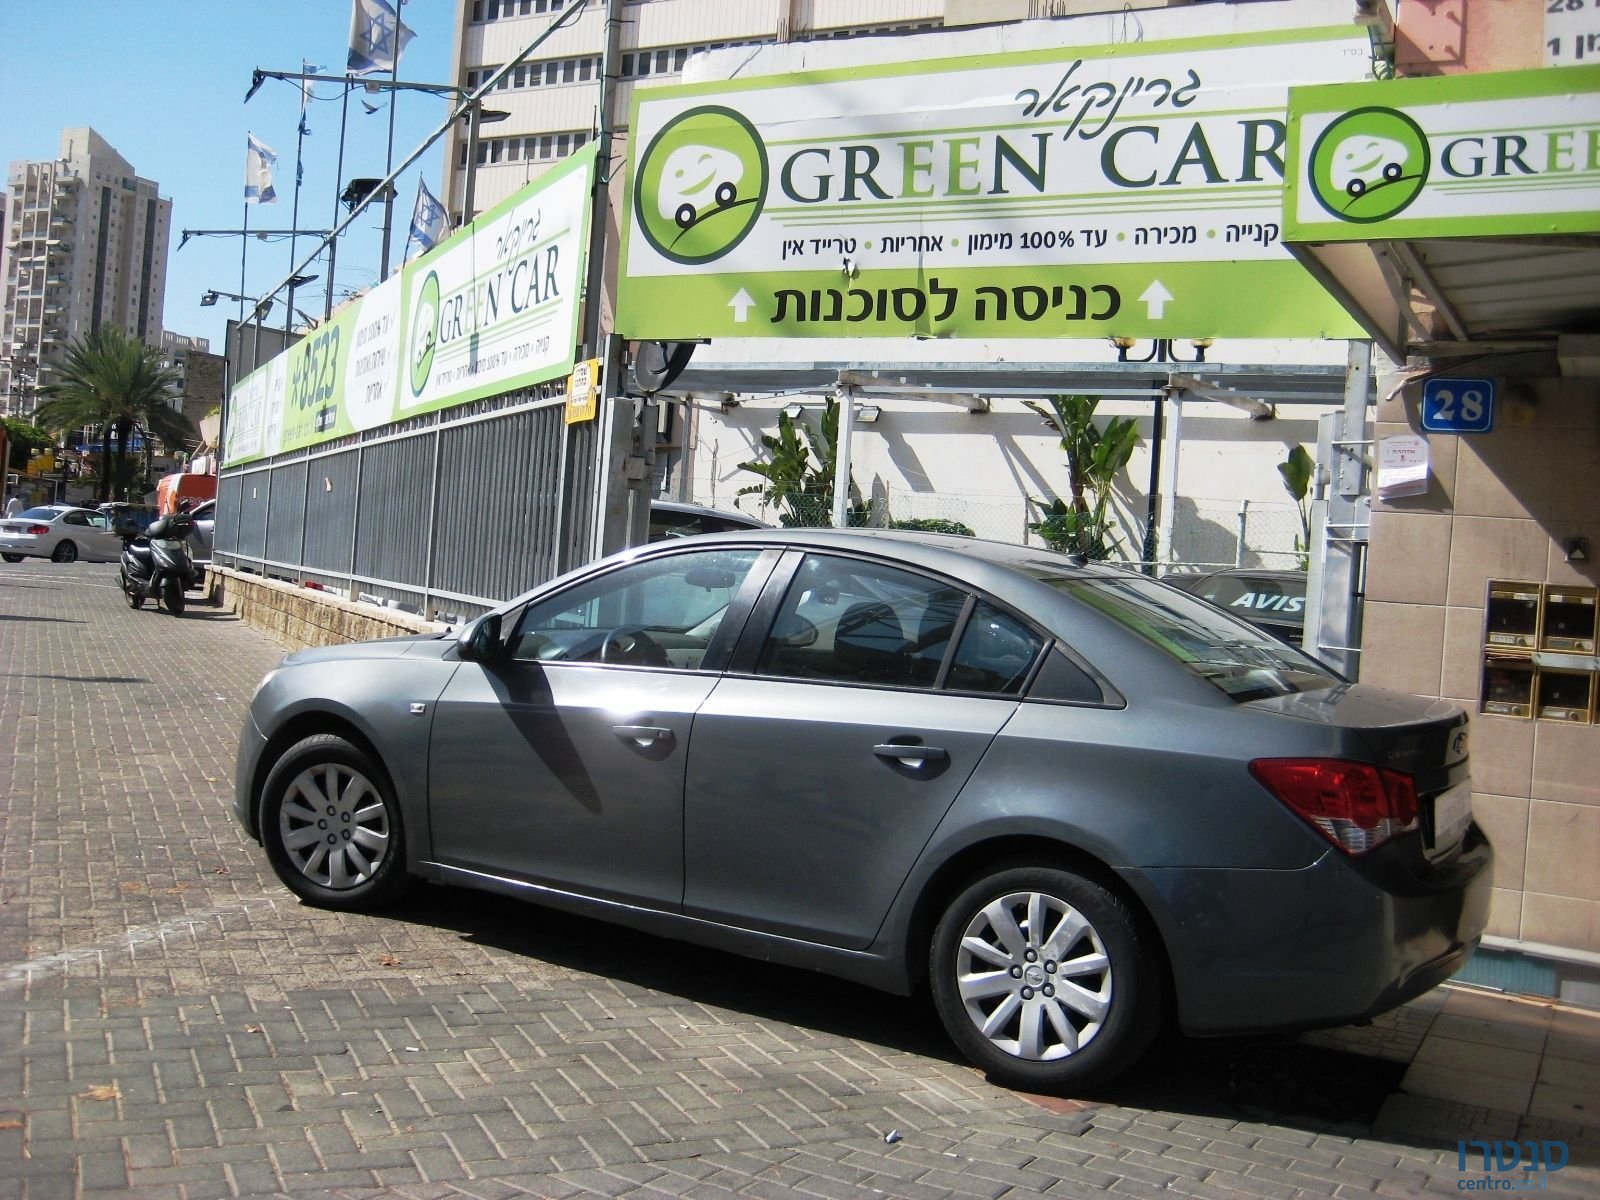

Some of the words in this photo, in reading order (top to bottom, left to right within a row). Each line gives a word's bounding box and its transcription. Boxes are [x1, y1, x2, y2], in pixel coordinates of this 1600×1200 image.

[780, 132, 1053, 204] GREEN
[1100, 119, 1286, 188] CAR
[810, 237, 857, 254] טרייד
[880, 235, 944, 254] אחריות
[967, 232, 1013, 256] מימון
[1020, 230, 1075, 249] 100%
[1080, 229, 1108, 248] עד
[1134, 225, 1197, 245] מכירה
[1225, 223, 1279, 247] קנייה
[782, 239, 804, 260] אין
[440, 273, 502, 343] GREEN
[511, 244, 560, 314] CAR
[770, 277, 958, 323] לסוכנות
[975, 284, 1121, 322] כניסה
[1433, 389, 1483, 421] 28
[1229, 592, 1306, 612] AVIS
